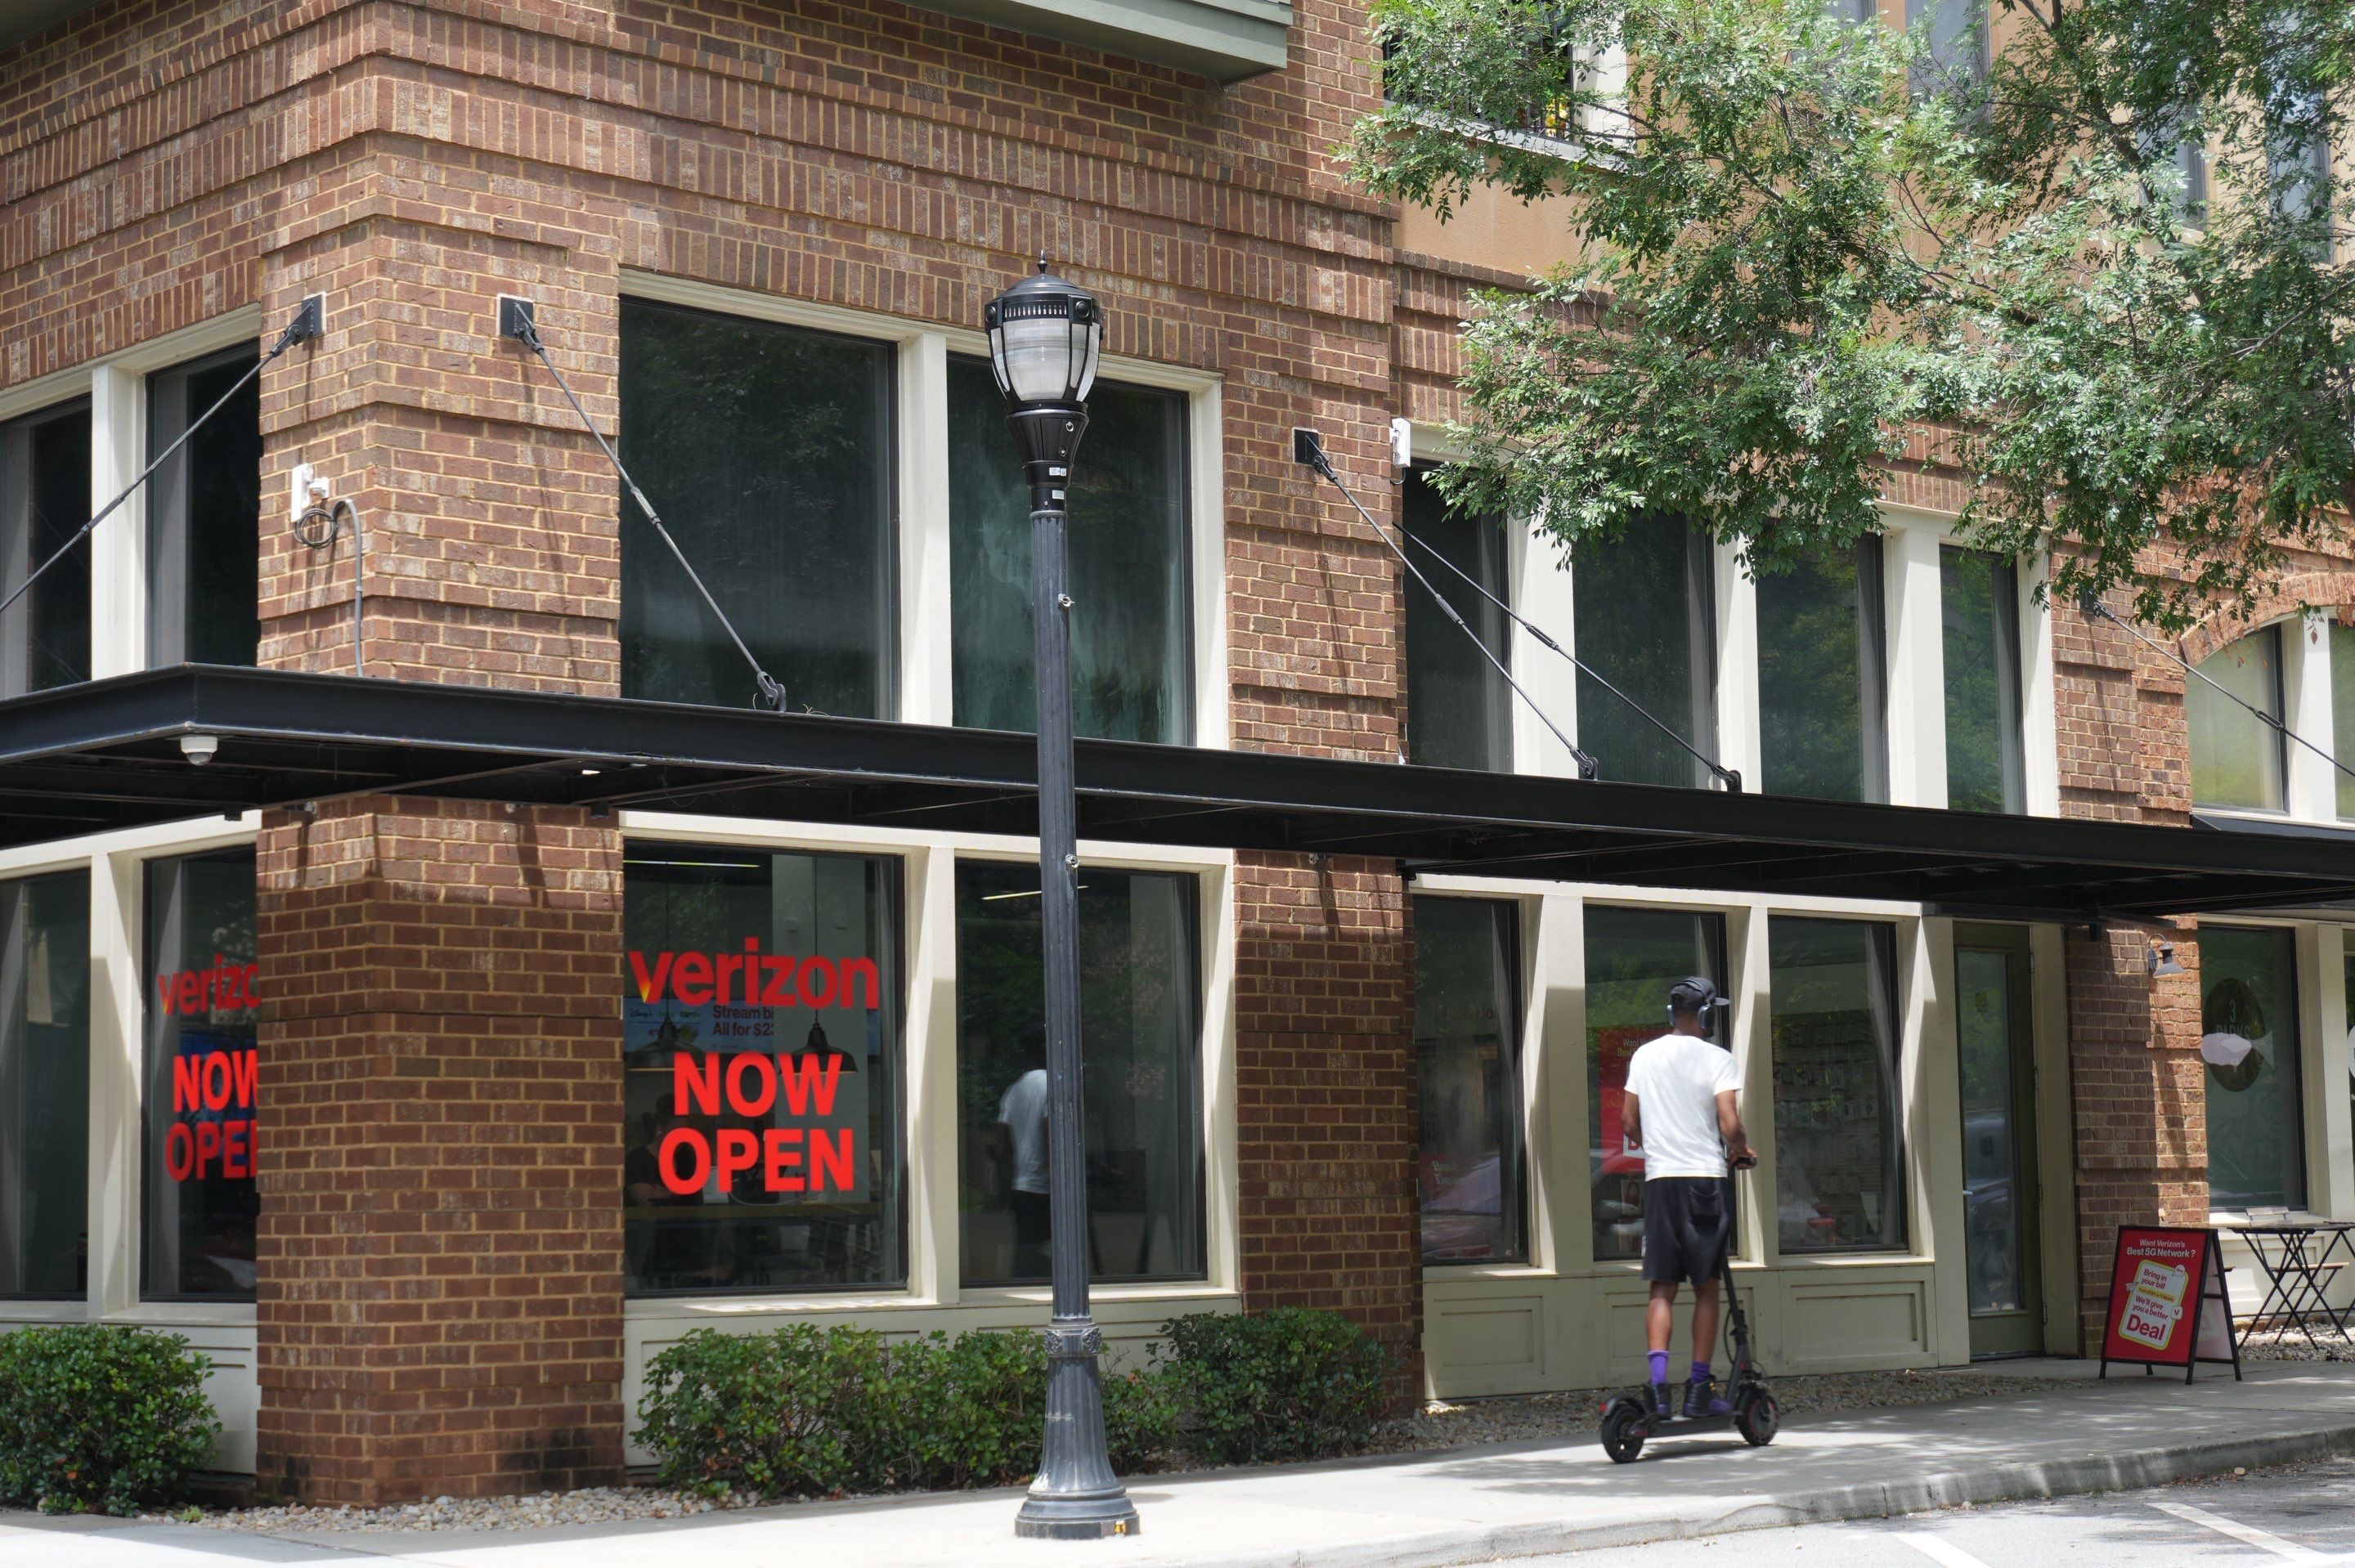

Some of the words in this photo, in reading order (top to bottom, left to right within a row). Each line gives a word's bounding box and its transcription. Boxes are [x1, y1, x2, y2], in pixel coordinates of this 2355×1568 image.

[628, 936, 880, 1009] verizon
[158, 953, 262, 1015] verizo
[713, 1005, 760, 1019] Stream
[2229, 1000, 2236, 1023] 3
[712, 1023, 729, 1036] All
[732, 1023, 751, 1036] for
[673, 1051, 843, 1118] NOW
[166, 1119, 258, 1182] OPE
[657, 1127, 855, 1195] OPEN
[2139, 1239, 2156, 1247] Want
[2156, 1239, 2186, 1248] Verizon's
[2127, 1247, 2144, 1256] Best
[2145, 1248, 2156, 1256] 5G
[2156, 1248, 2190, 1257] Network
[2143, 1269, 2160, 1281] Bring
[2141, 1278, 2155, 1287] your
[2155, 1280, 2166, 1289] bill
[2135, 1295, 2151, 1306] We'll
[2150, 1301, 2164, 1310] give
[2133, 1304, 2144, 1312] you
[2149, 1309, 2169, 1320] better
[2126, 1313, 2166, 1341] Deal
